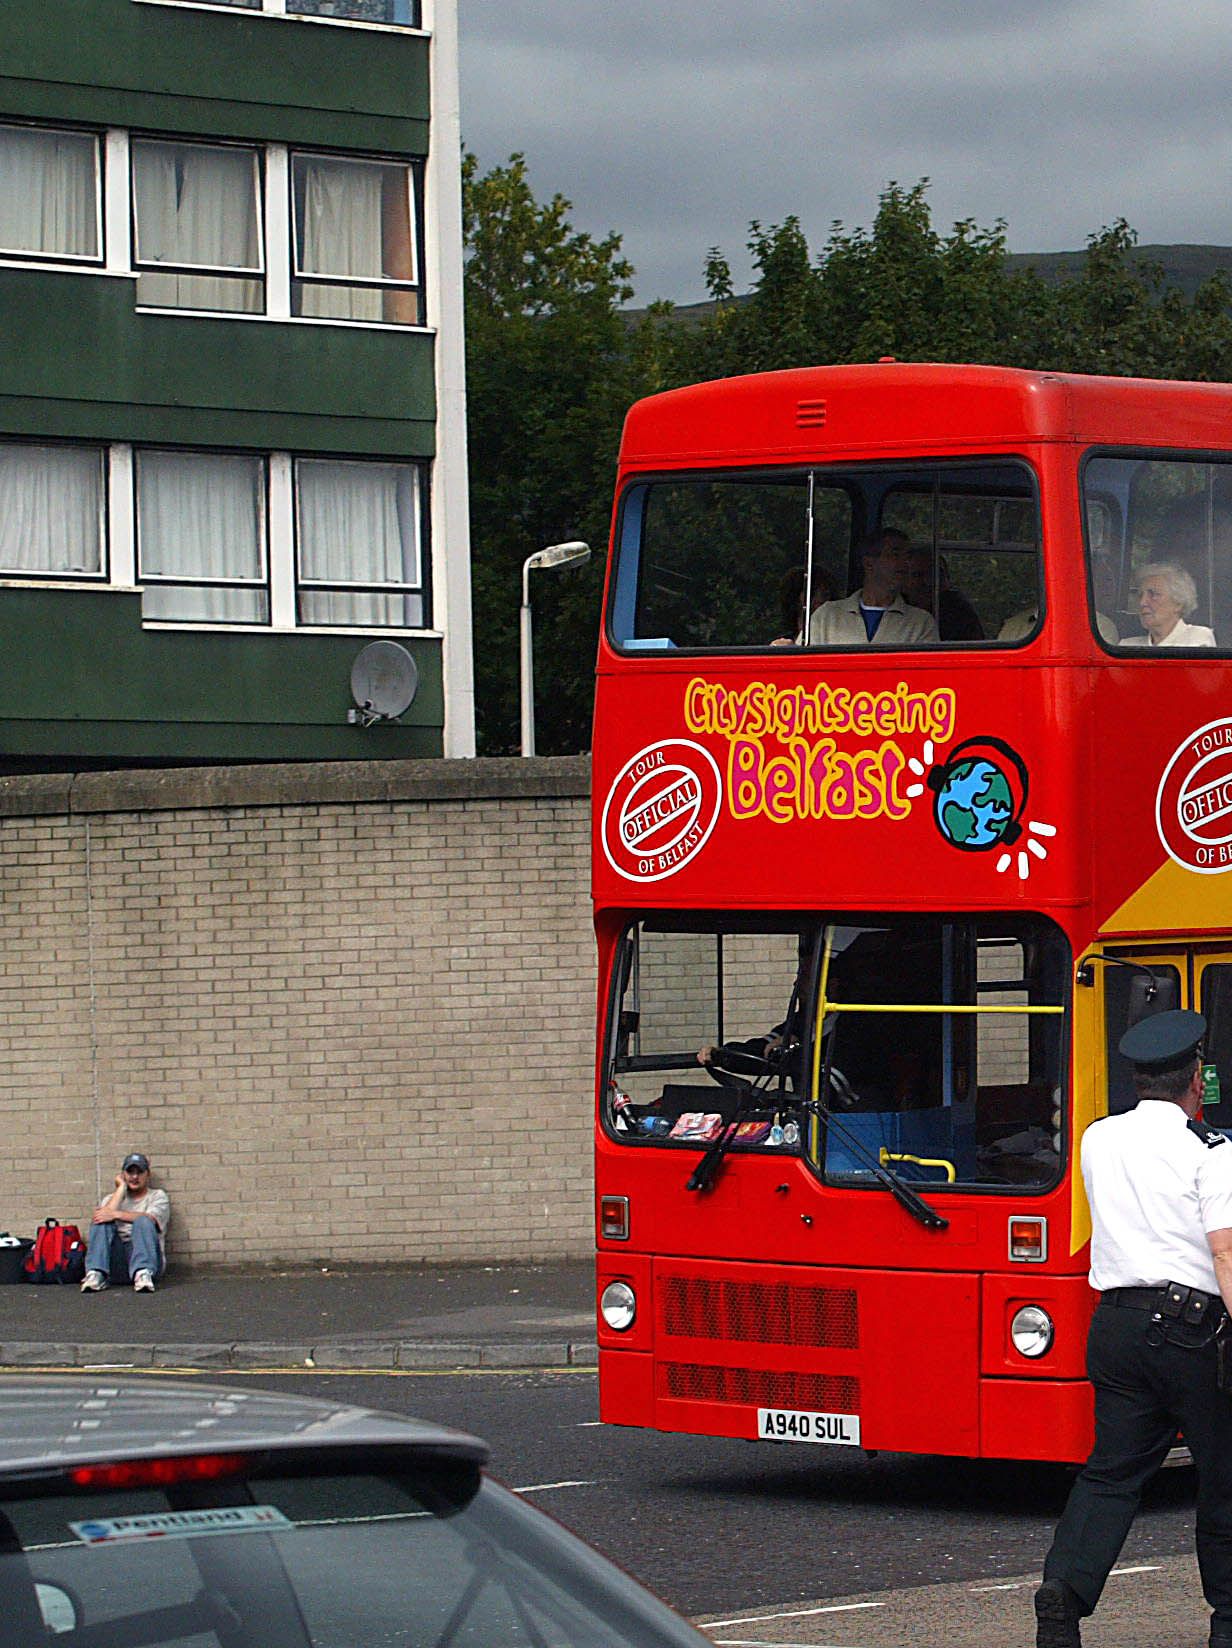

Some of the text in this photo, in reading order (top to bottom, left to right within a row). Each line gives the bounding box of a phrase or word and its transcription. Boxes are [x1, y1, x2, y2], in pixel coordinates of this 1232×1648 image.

[627, 751, 666, 784] TOUR
[727, 735, 911, 823] Belfast
[624, 782, 697, 841] OFFICIAL
[638, 820, 704, 874] OF BELFAST
[1195, 847, 1215, 864] OF
[765, 1413, 851, 1440] A940 SUL
[113, 1510, 244, 1531] Pentland
